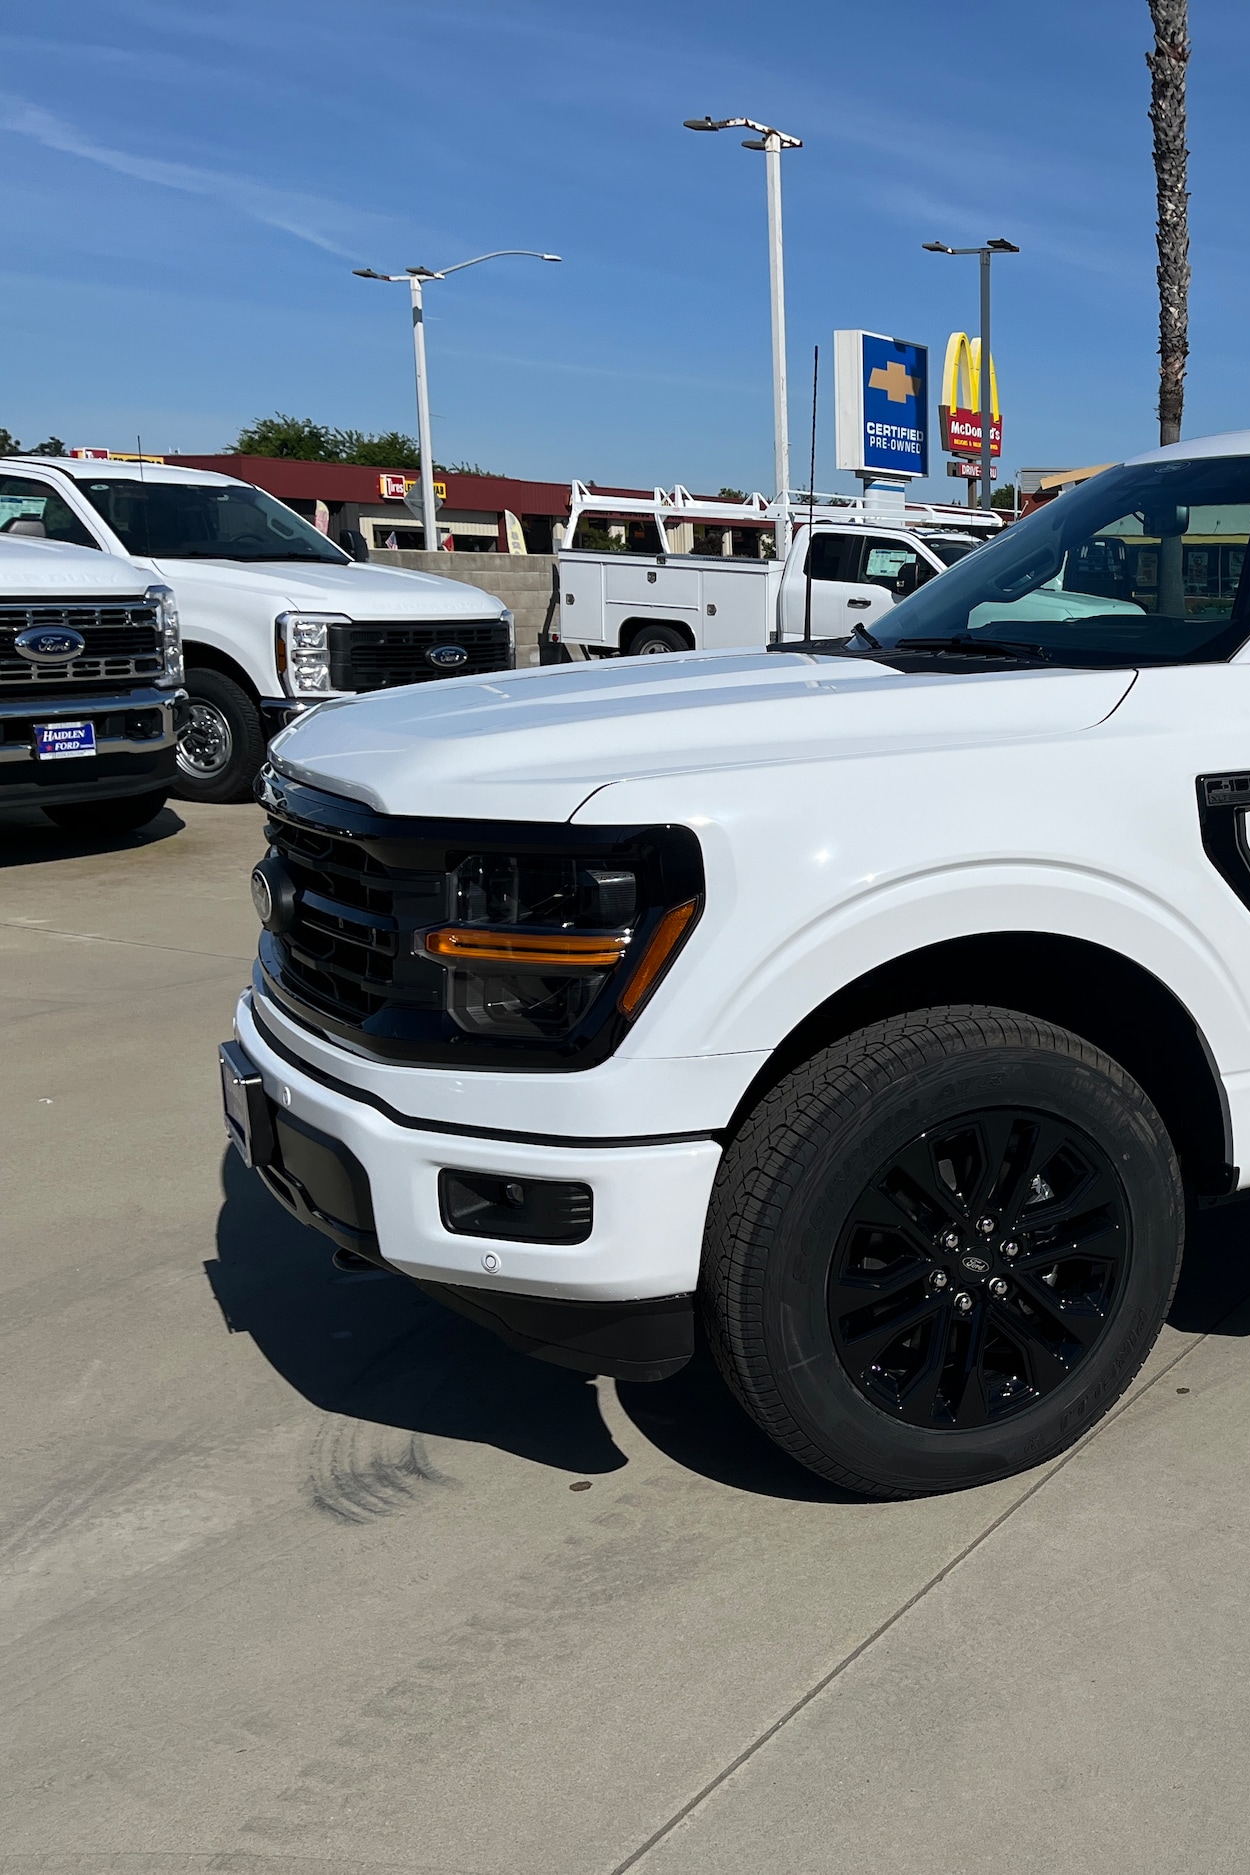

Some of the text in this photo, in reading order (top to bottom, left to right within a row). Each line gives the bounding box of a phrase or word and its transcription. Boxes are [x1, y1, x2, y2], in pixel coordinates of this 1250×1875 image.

[866, 421, 924, 442] CERTIFIED
[950, 420, 1001, 441] McDond's
[869, 435, 922, 454] PRE-OWNED
[386, 477, 404, 496] Tires
[43, 729, 86, 743] HAIDLEN
[54, 741, 80, 751] FORD
[1211, 794, 1228, 802] XLT
